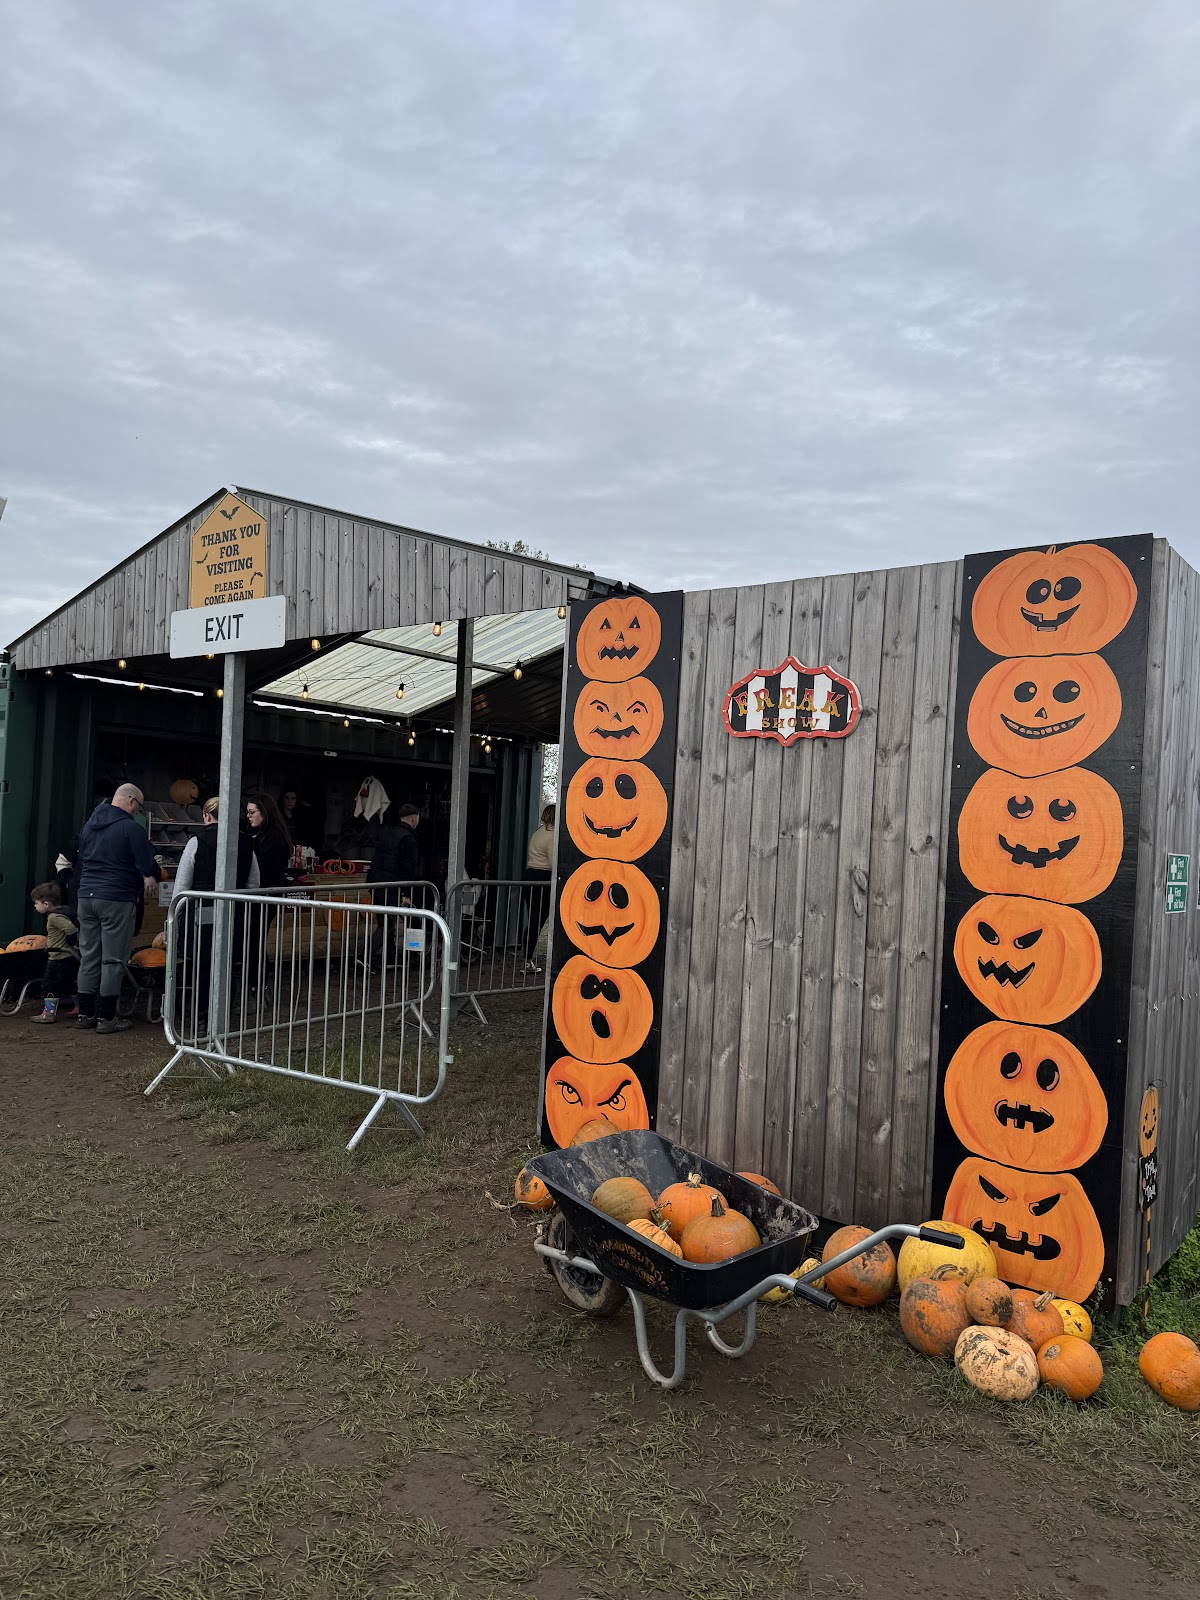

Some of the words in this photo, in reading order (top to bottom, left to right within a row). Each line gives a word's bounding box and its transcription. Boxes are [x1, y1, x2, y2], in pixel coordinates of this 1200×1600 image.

[201, 528, 238, 547] THANK
[240, 523, 261, 540] YOU
[219, 543, 240, 559] FOR
[206, 556, 253, 577] VISITING
[214, 579, 244, 593] PLEASE
[204, 594, 226, 606] COME
[227, 589, 254, 602] AGAIN
[205, 613, 244, 643] EXIT
[733, 687, 845, 718] FREAK
[761, 716, 820, 729] SHOW
